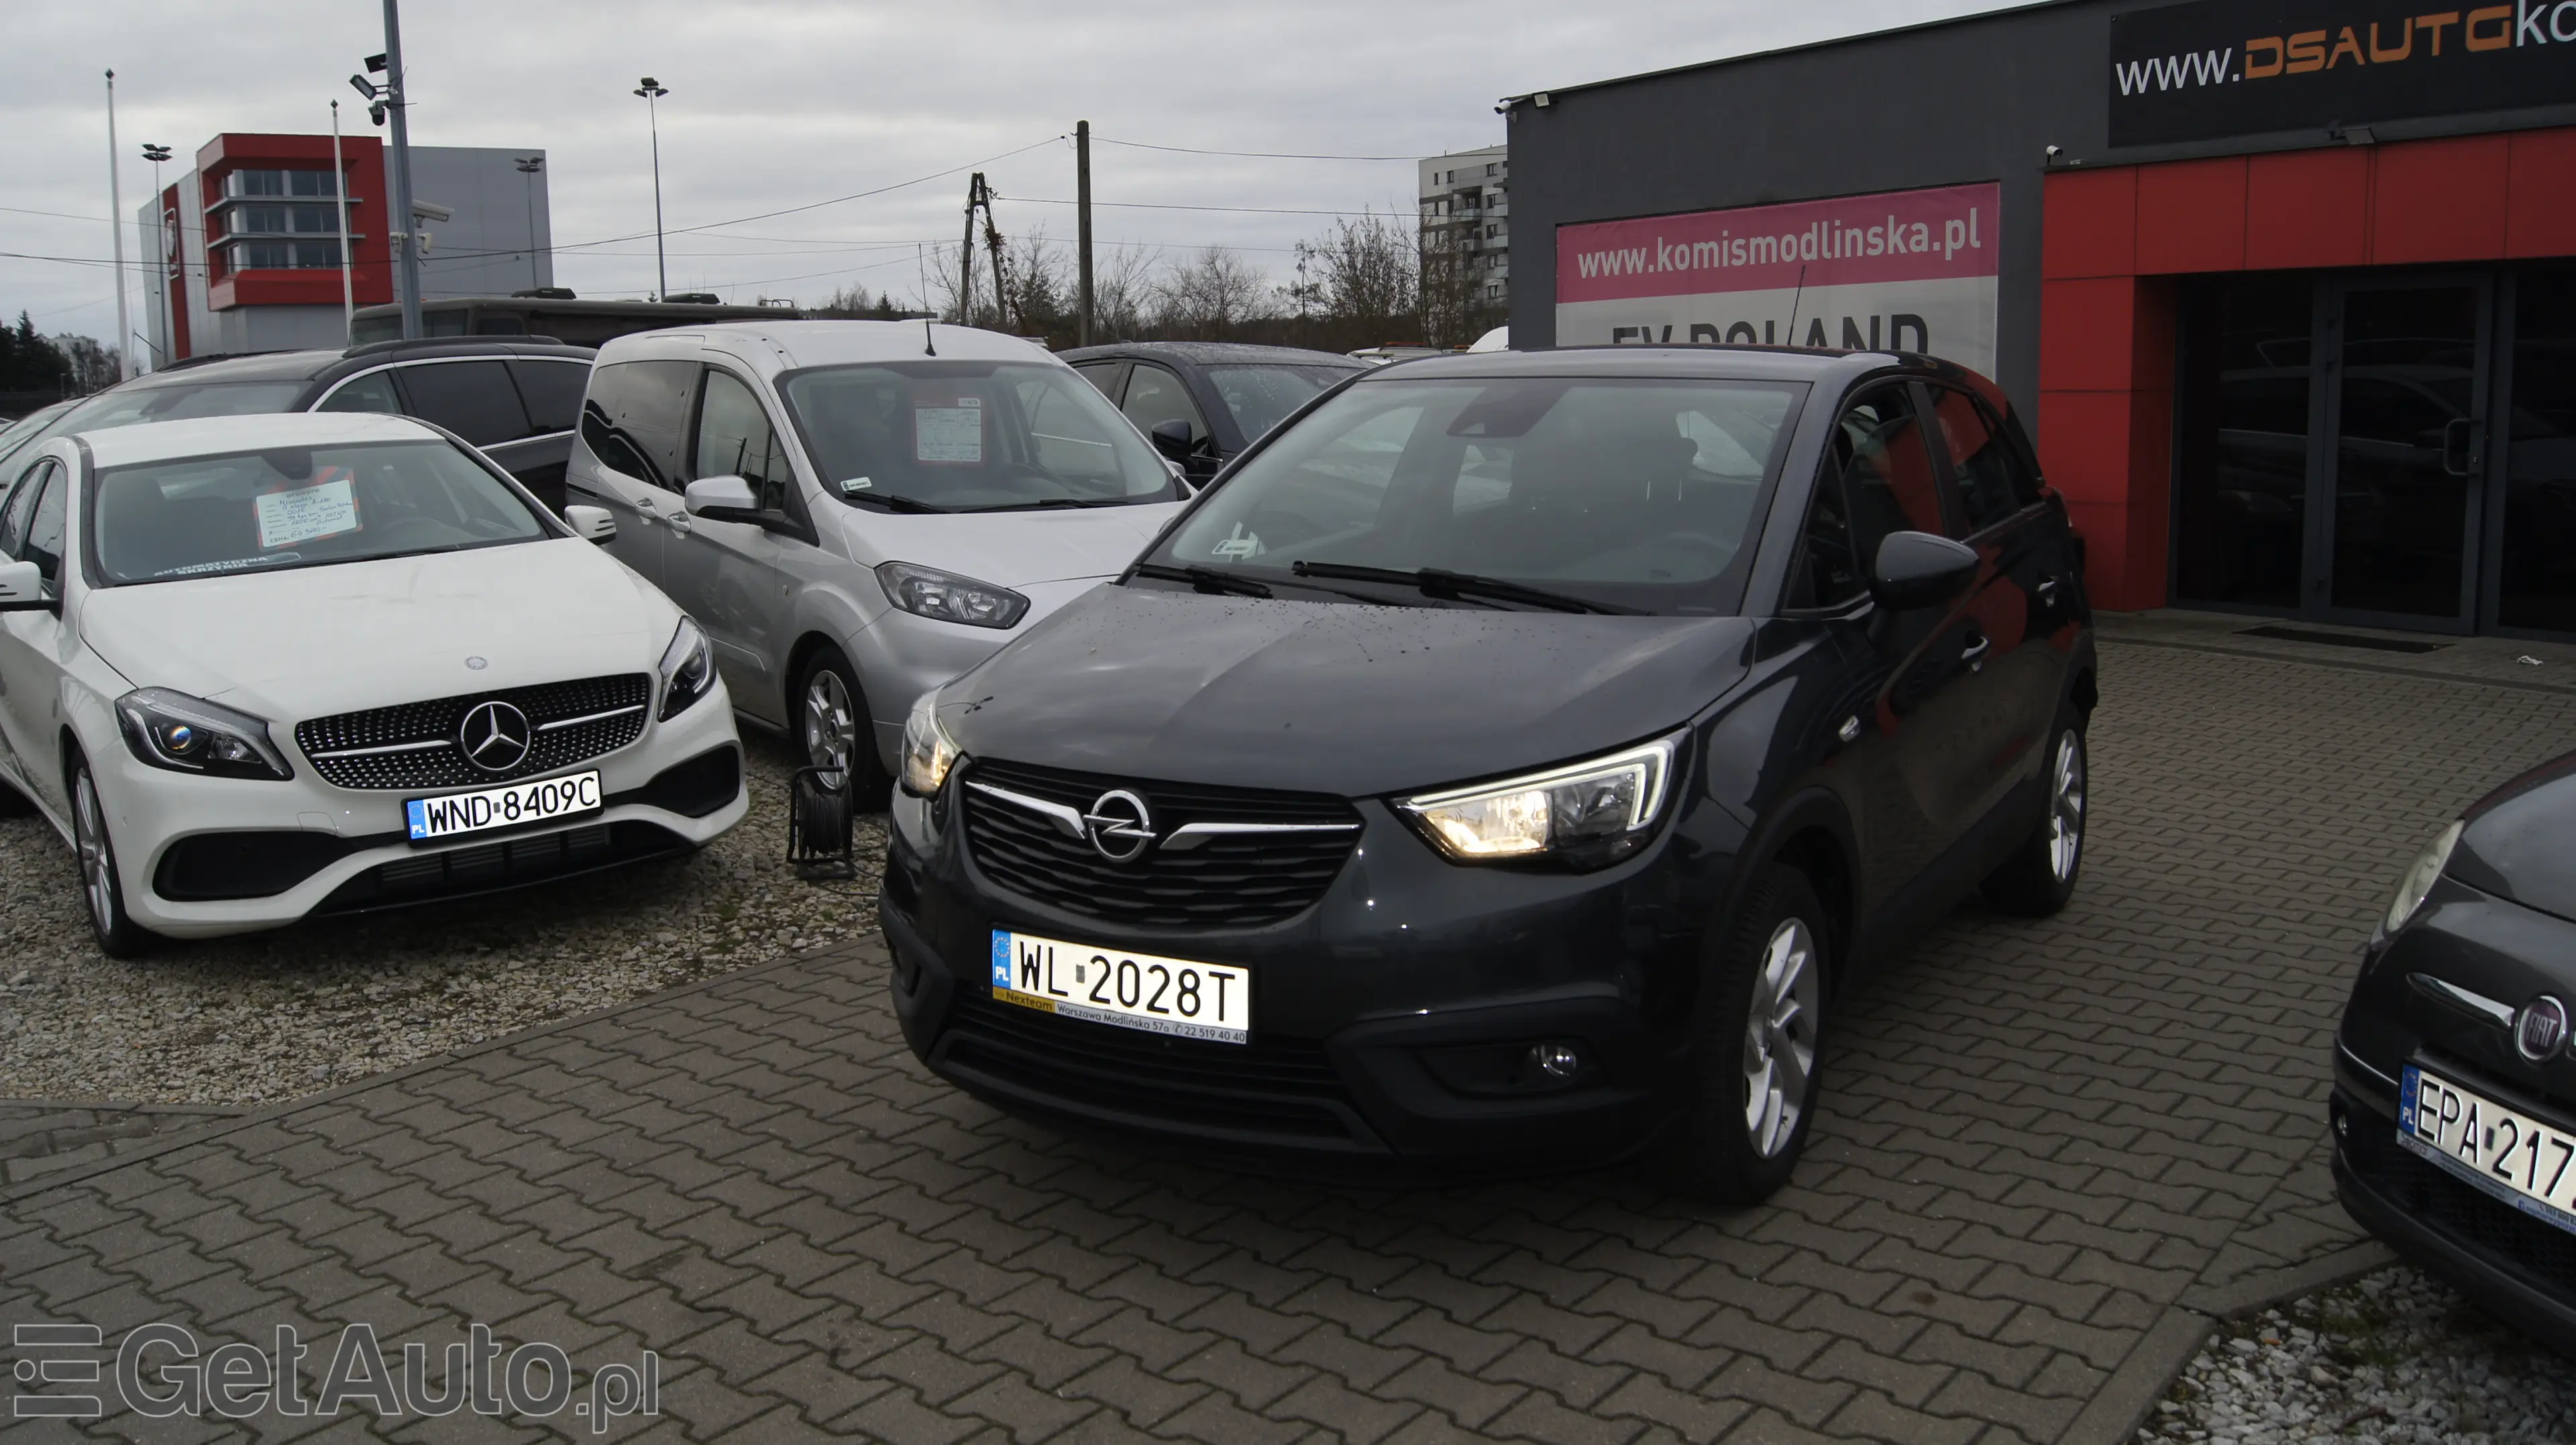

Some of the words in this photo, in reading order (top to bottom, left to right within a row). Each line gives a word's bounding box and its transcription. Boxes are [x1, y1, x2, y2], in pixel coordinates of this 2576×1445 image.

[1578, 207, 1981, 278] www.komismodlinska.pl
[411, 824, 425, 835] PL
[427, 796, 492, 833] WND
[503, 776, 597, 821] 8409C
[996, 966, 1009, 981] PL
[1020, 941, 1069, 997] WL
[1089, 955, 1236, 1022] 2028T
[1006, 992, 1053, 1011] Nexteam
[1057, 1005, 1102, 1022] Warszawa
[1104, 1013, 1150, 1029] Modlińska
[1152, 1021, 1170, 1033] 57a
[1184, 1026, 1197, 1037] 22
[1199, 1029, 1215, 1039] 519
[1218, 1031, 1230, 1041] 40
[1232, 1032, 1246, 1042] 40
[2526, 1012, 2557, 1047] FIAT
[2403, 1106, 2414, 1126] PL
[2418, 1079, 2480, 1165] EPA
[2492, 1118, 2576, 1210] 217
